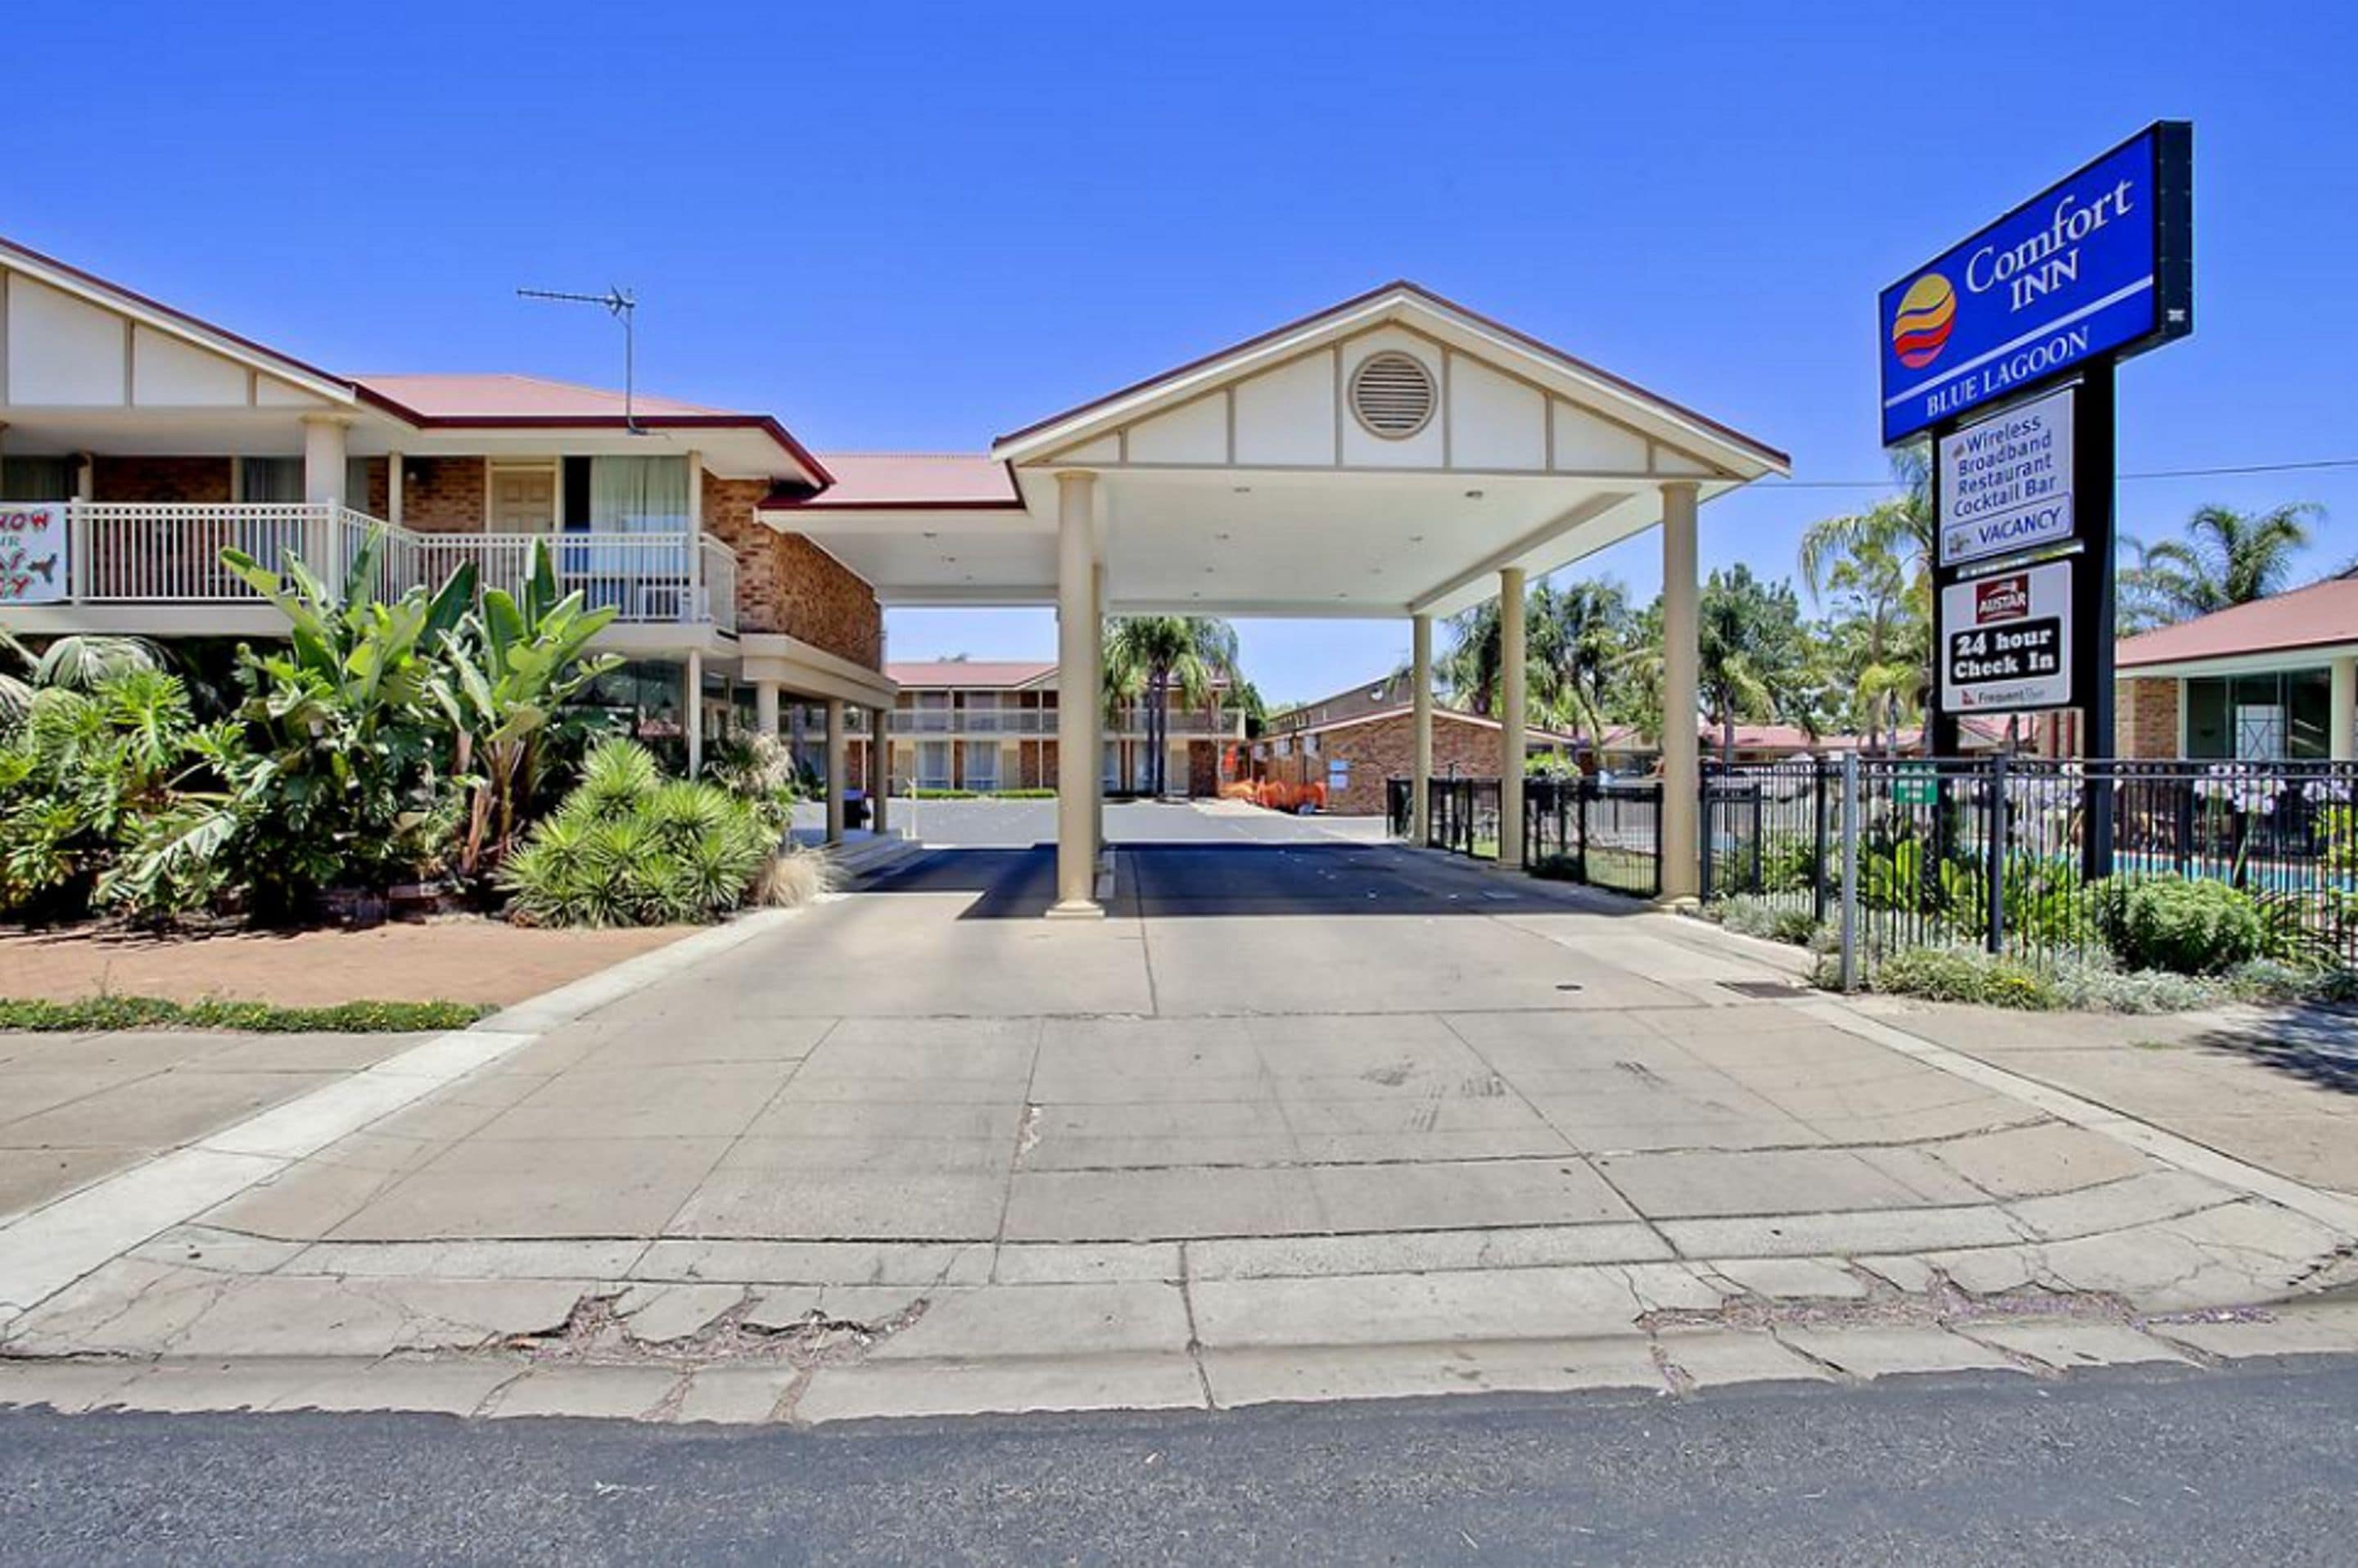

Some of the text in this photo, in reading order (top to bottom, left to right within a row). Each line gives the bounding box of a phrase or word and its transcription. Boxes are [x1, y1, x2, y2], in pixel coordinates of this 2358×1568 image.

[1966, 178, 2134, 293] Comfort
[2010, 248, 2080, 314] INN
[1926, 325, 2089, 418] BLUE LAGOON
[1958, 429, 2052, 477] Broadband
[1967, 415, 2042, 453] Wireless
[1958, 453, 2053, 496] Restaurant
[1954, 476, 2057, 517] Cocktail Bar
[1978, 506, 2062, 545] VACANCY
[1956, 628, 2053, 657] 24 hour
[1954, 652, 2054, 679] Check In
